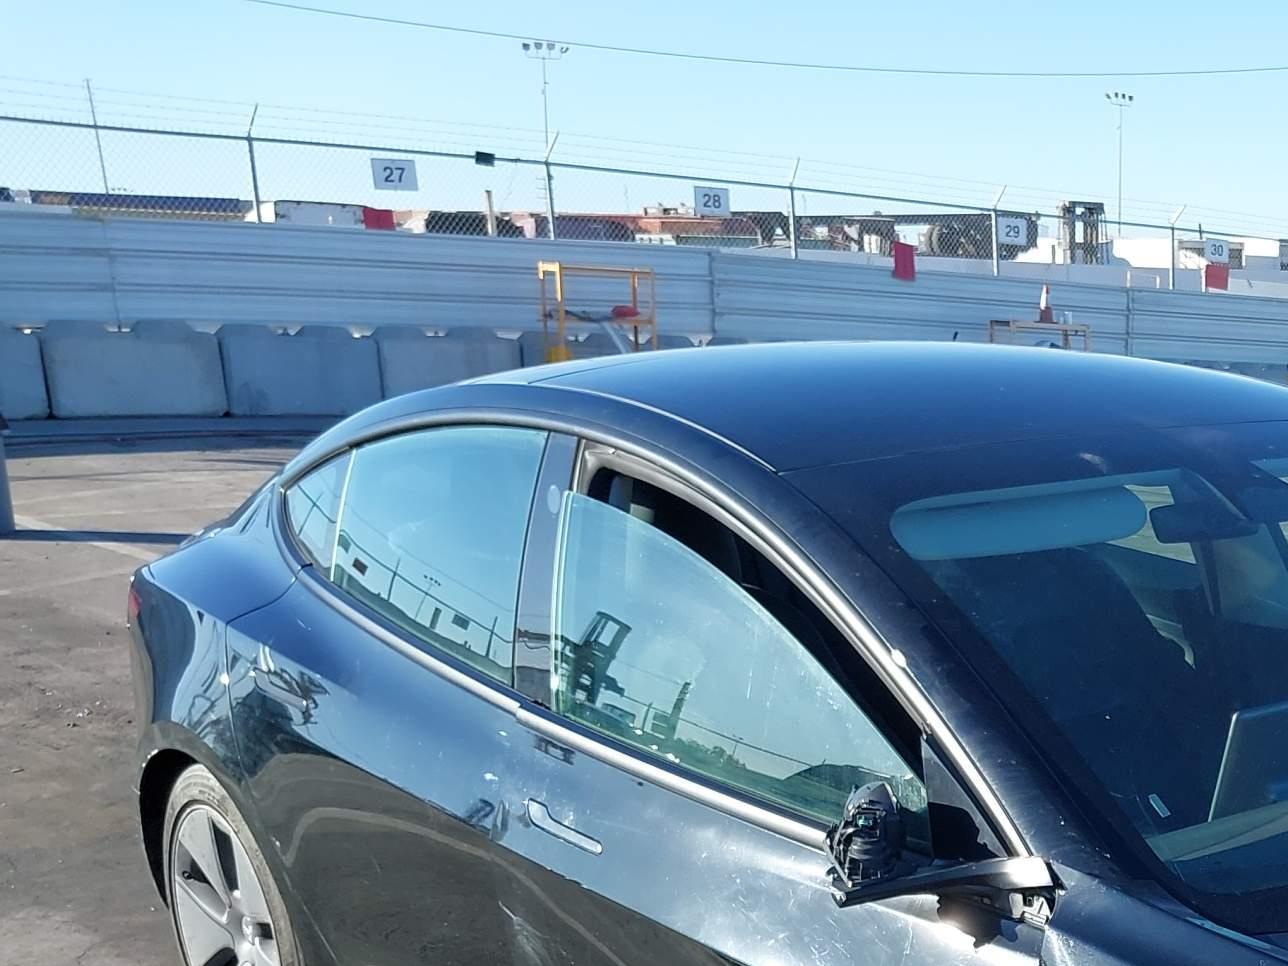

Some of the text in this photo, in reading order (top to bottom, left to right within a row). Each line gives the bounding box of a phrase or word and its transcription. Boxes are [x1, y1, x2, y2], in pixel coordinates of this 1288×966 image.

[383, 166, 405, 183] 27
[703, 193, 722, 209] 28
[1005, 224, 1020, 239] 29
[1210, 244, 1224, 257] 30
